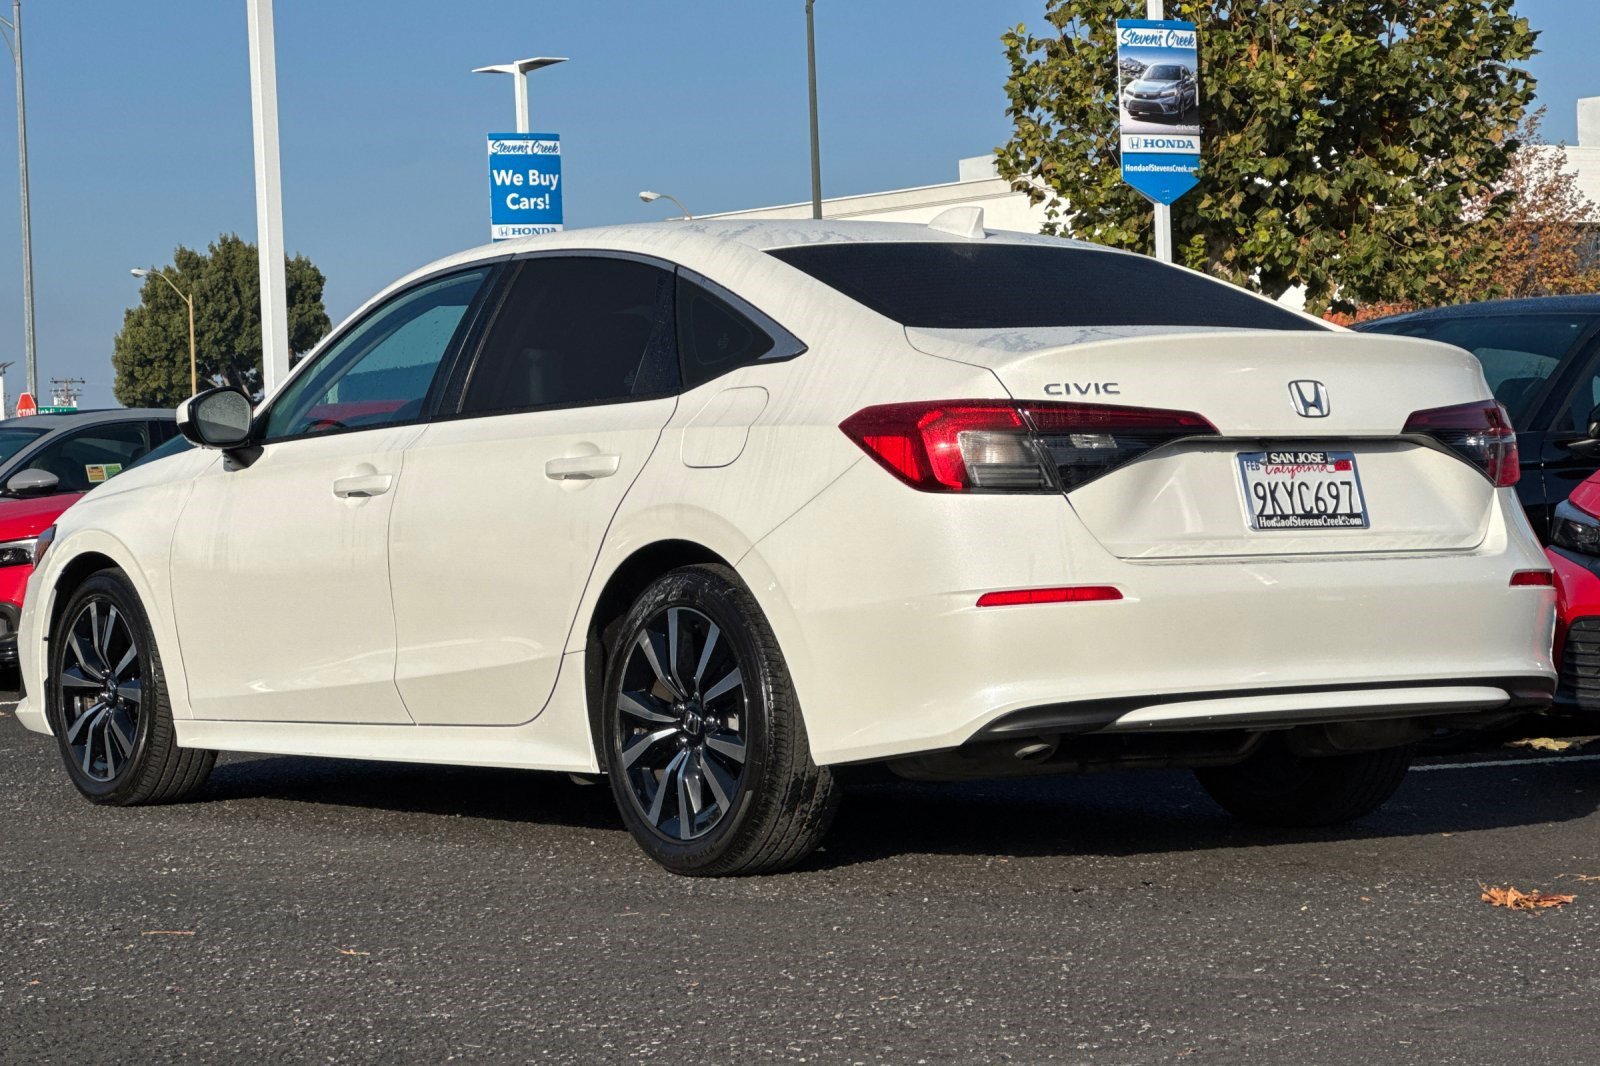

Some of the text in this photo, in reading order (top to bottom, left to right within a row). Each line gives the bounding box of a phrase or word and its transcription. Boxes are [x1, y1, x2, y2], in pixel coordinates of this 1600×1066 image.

[1121, 28, 1196, 48] Stevens Creek
[491, 140, 559, 155] Stevens Creek
[1143, 138, 1195, 149] HONDA
[493, 169, 559, 191] We Buy
[506, 192, 550, 210] Cars!
[511, 227, 557, 236] HONDA
[1043, 382, 1121, 395] CIVIC
[1270, 453, 1326, 463] SAN JOSE
[1246, 461, 1260, 471] FEB
[1265, 464, 1337, 479] California
[1253, 480, 1354, 515] 9KYC697
[1259, 514, 1363, 528] HondaofStevensCreek.com
